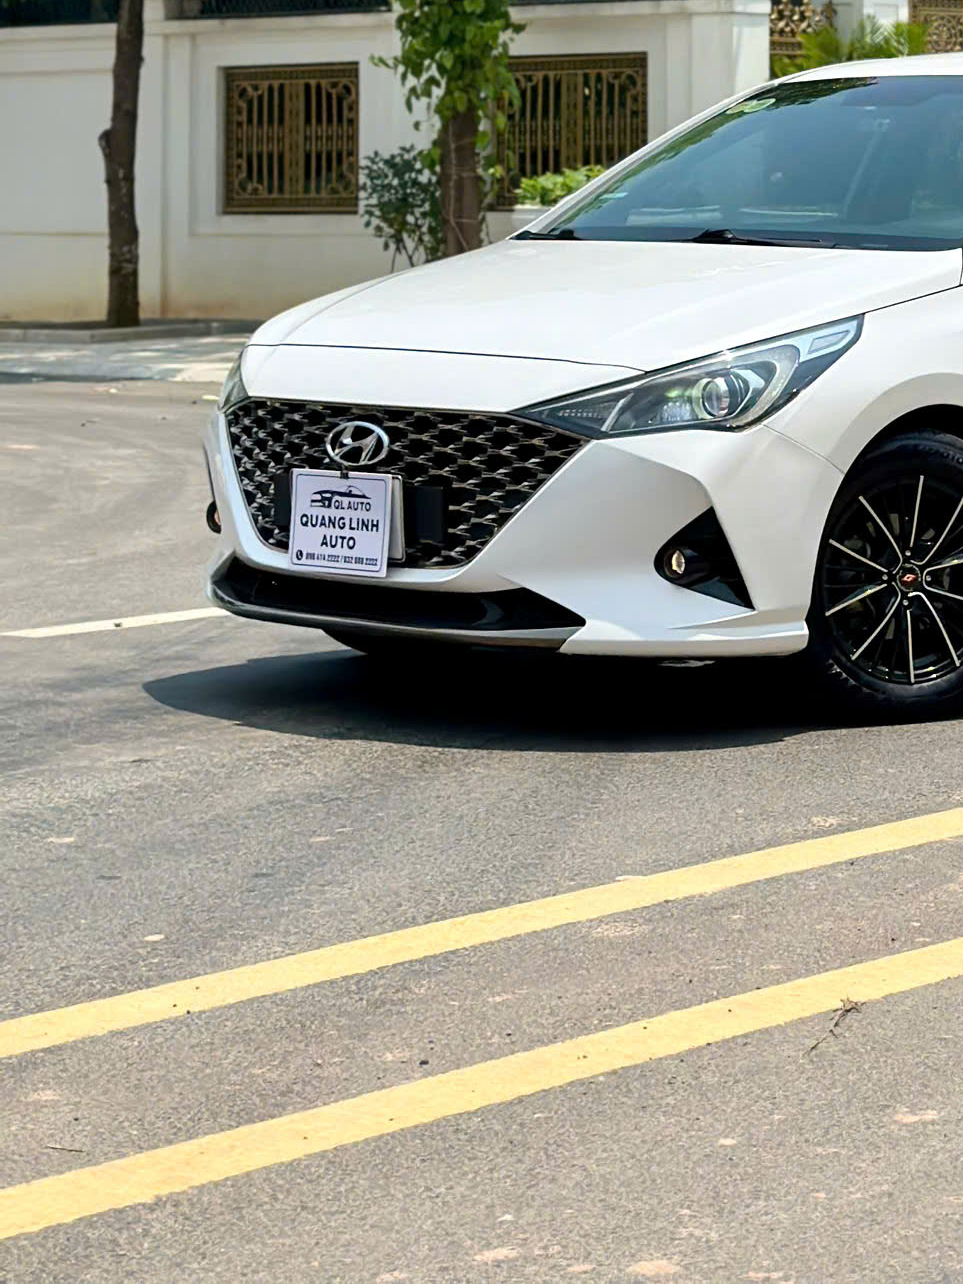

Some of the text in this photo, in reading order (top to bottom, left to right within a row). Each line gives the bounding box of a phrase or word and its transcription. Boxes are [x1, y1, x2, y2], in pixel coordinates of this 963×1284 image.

[334, 500, 372, 512] QL AUTO
[300, 513, 379, 532] QUANG LINH
[320, 534, 356, 550] AUTO
